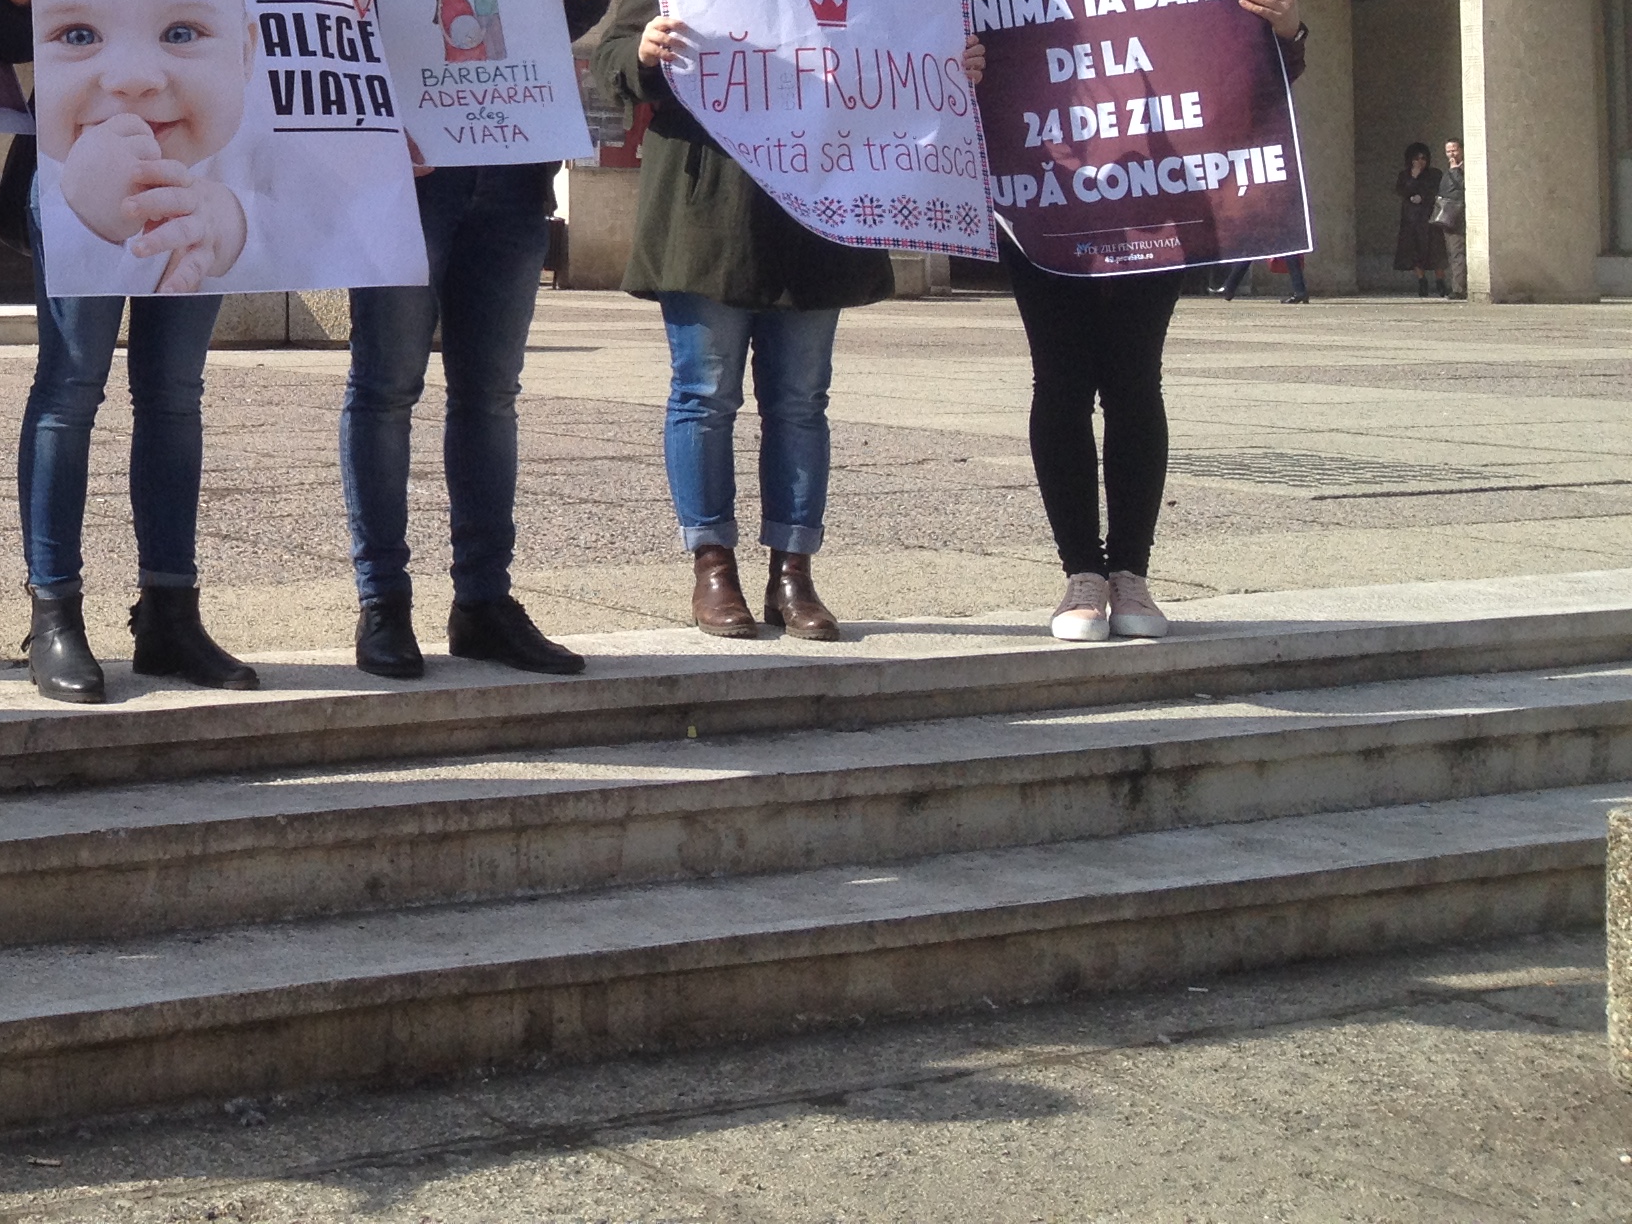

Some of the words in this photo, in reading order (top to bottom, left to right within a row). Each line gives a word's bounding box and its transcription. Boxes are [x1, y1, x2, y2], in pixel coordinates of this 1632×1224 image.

[258, 12, 381, 63] ALEGE
[1046, 43, 1096, 84] DE
[1100, 36, 1154, 77] LA
[267, 69, 395, 126] VIAȚA
[699, 30, 776, 112] FĂT
[795, 47, 968, 117] FRUMOS
[466, 106, 509, 124] aleg
[1023, 107, 1063, 148] 24
[1070, 102, 1119, 142] DE
[1126, 91, 1204, 136] ZILE
[821, 130, 854, 172] să
[863, 130, 978, 179] trăiască
[990, 160, 1068, 208] UPĂ
[1072, 144, 1287, 203] CONCEPȚIE
[1118, 240, 1153, 251] PENTRU
